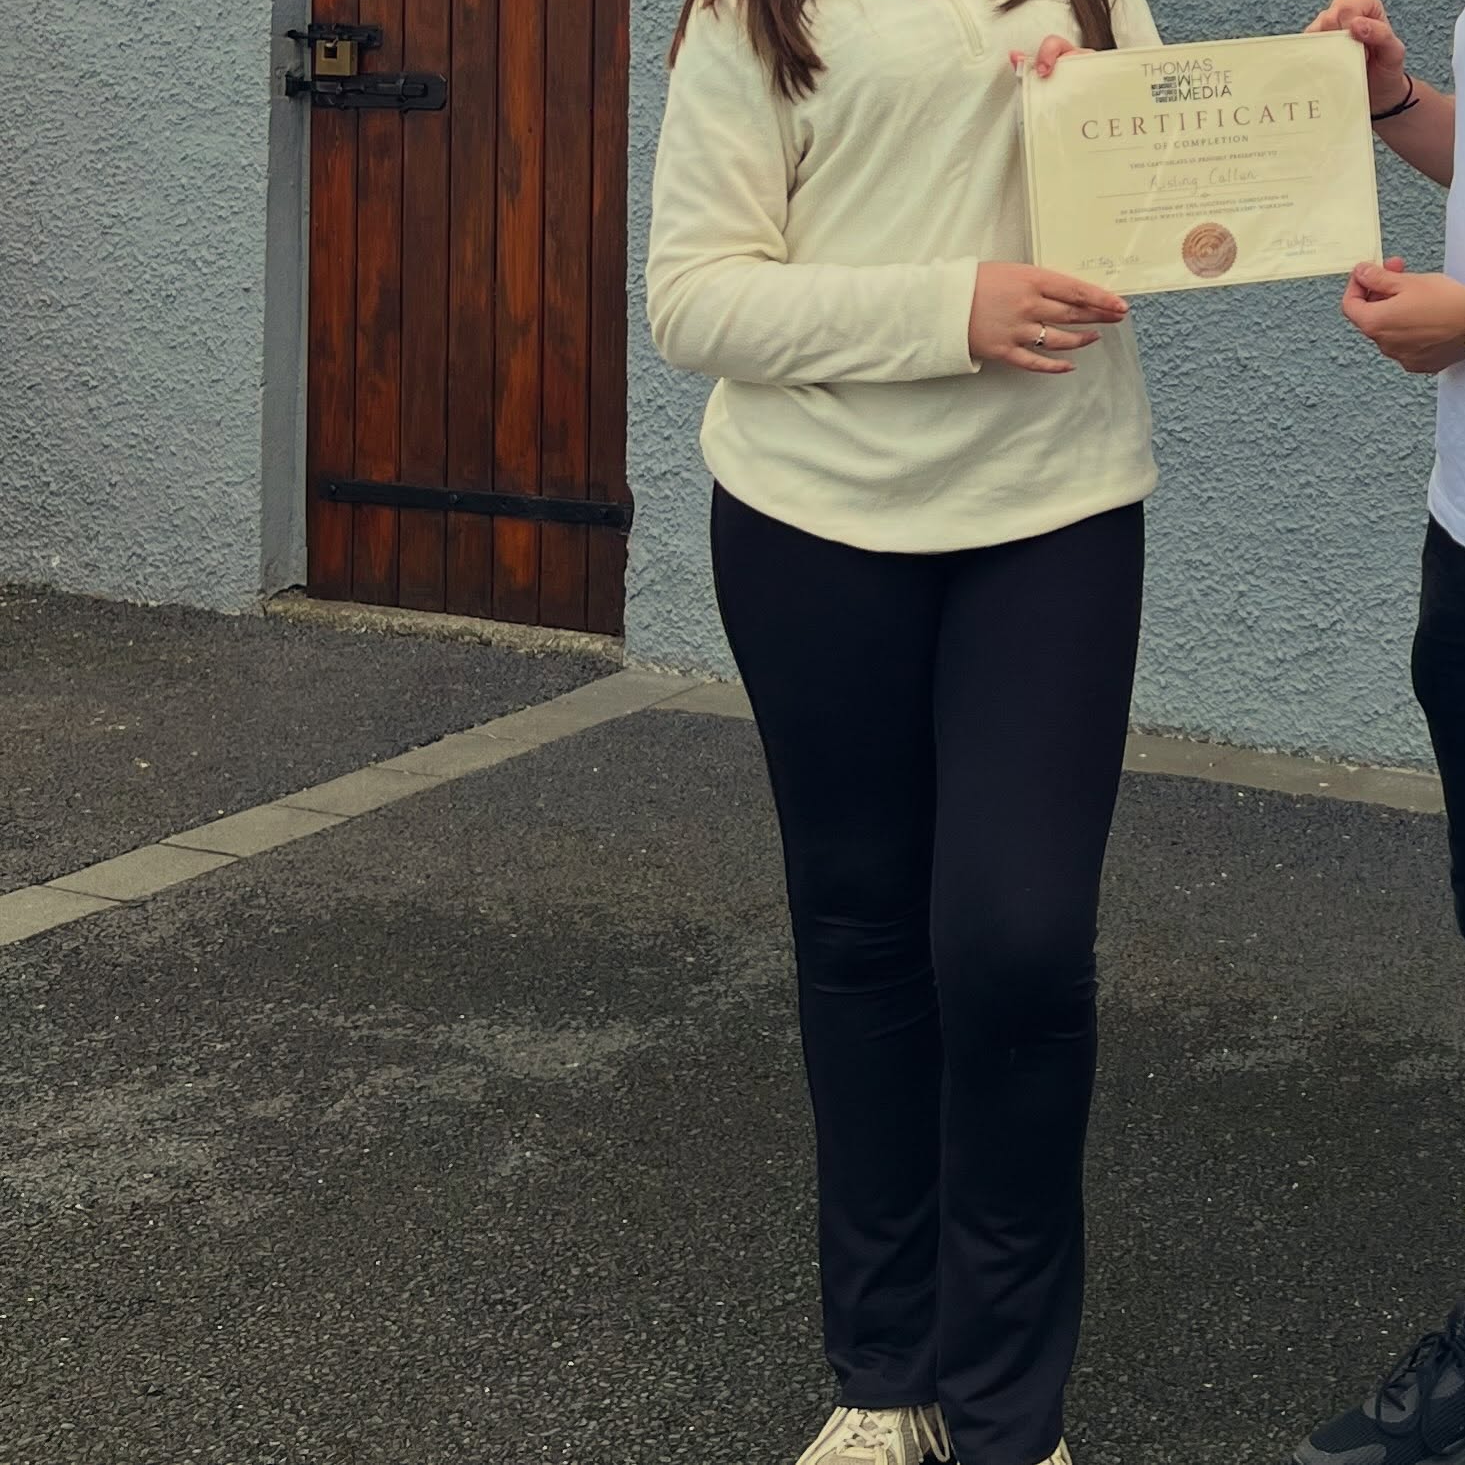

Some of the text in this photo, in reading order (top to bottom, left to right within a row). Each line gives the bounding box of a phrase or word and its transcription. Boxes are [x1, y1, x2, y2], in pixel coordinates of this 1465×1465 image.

[1141, 57, 1213, 77] THOMAS
[1177, 69, 1232, 88] WHYTE
[1178, 84, 1233, 102] MEDIA
[1082, 100, 1321, 139] CERTIFICATE
[1153, 135, 1249, 151] OF COMPLETION
